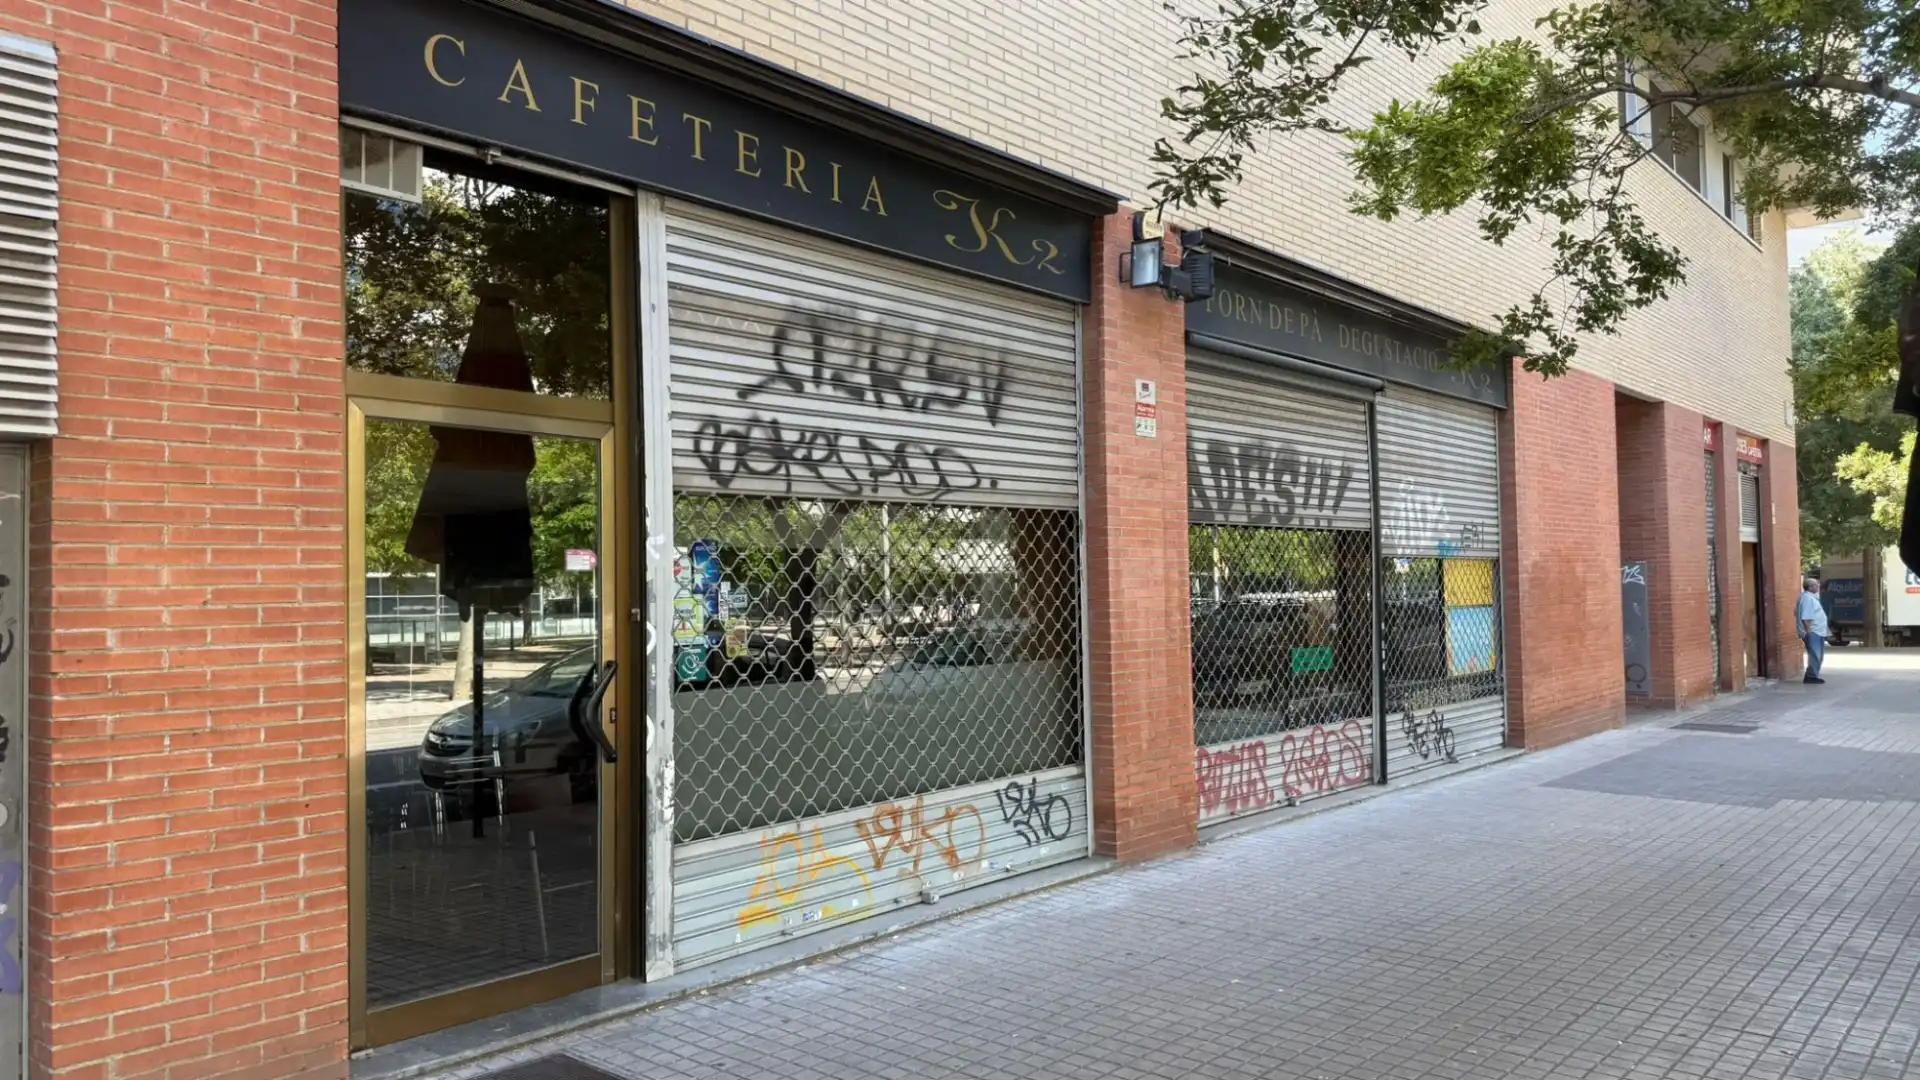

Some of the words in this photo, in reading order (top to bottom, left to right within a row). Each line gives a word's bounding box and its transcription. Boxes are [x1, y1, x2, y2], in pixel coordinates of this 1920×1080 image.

[423, 33, 889, 217] CAFETERIA
[932, 189, 1066, 275] K2
[1269, 302, 1295, 334] DE
[1299, 308, 1323, 343] PÀ
